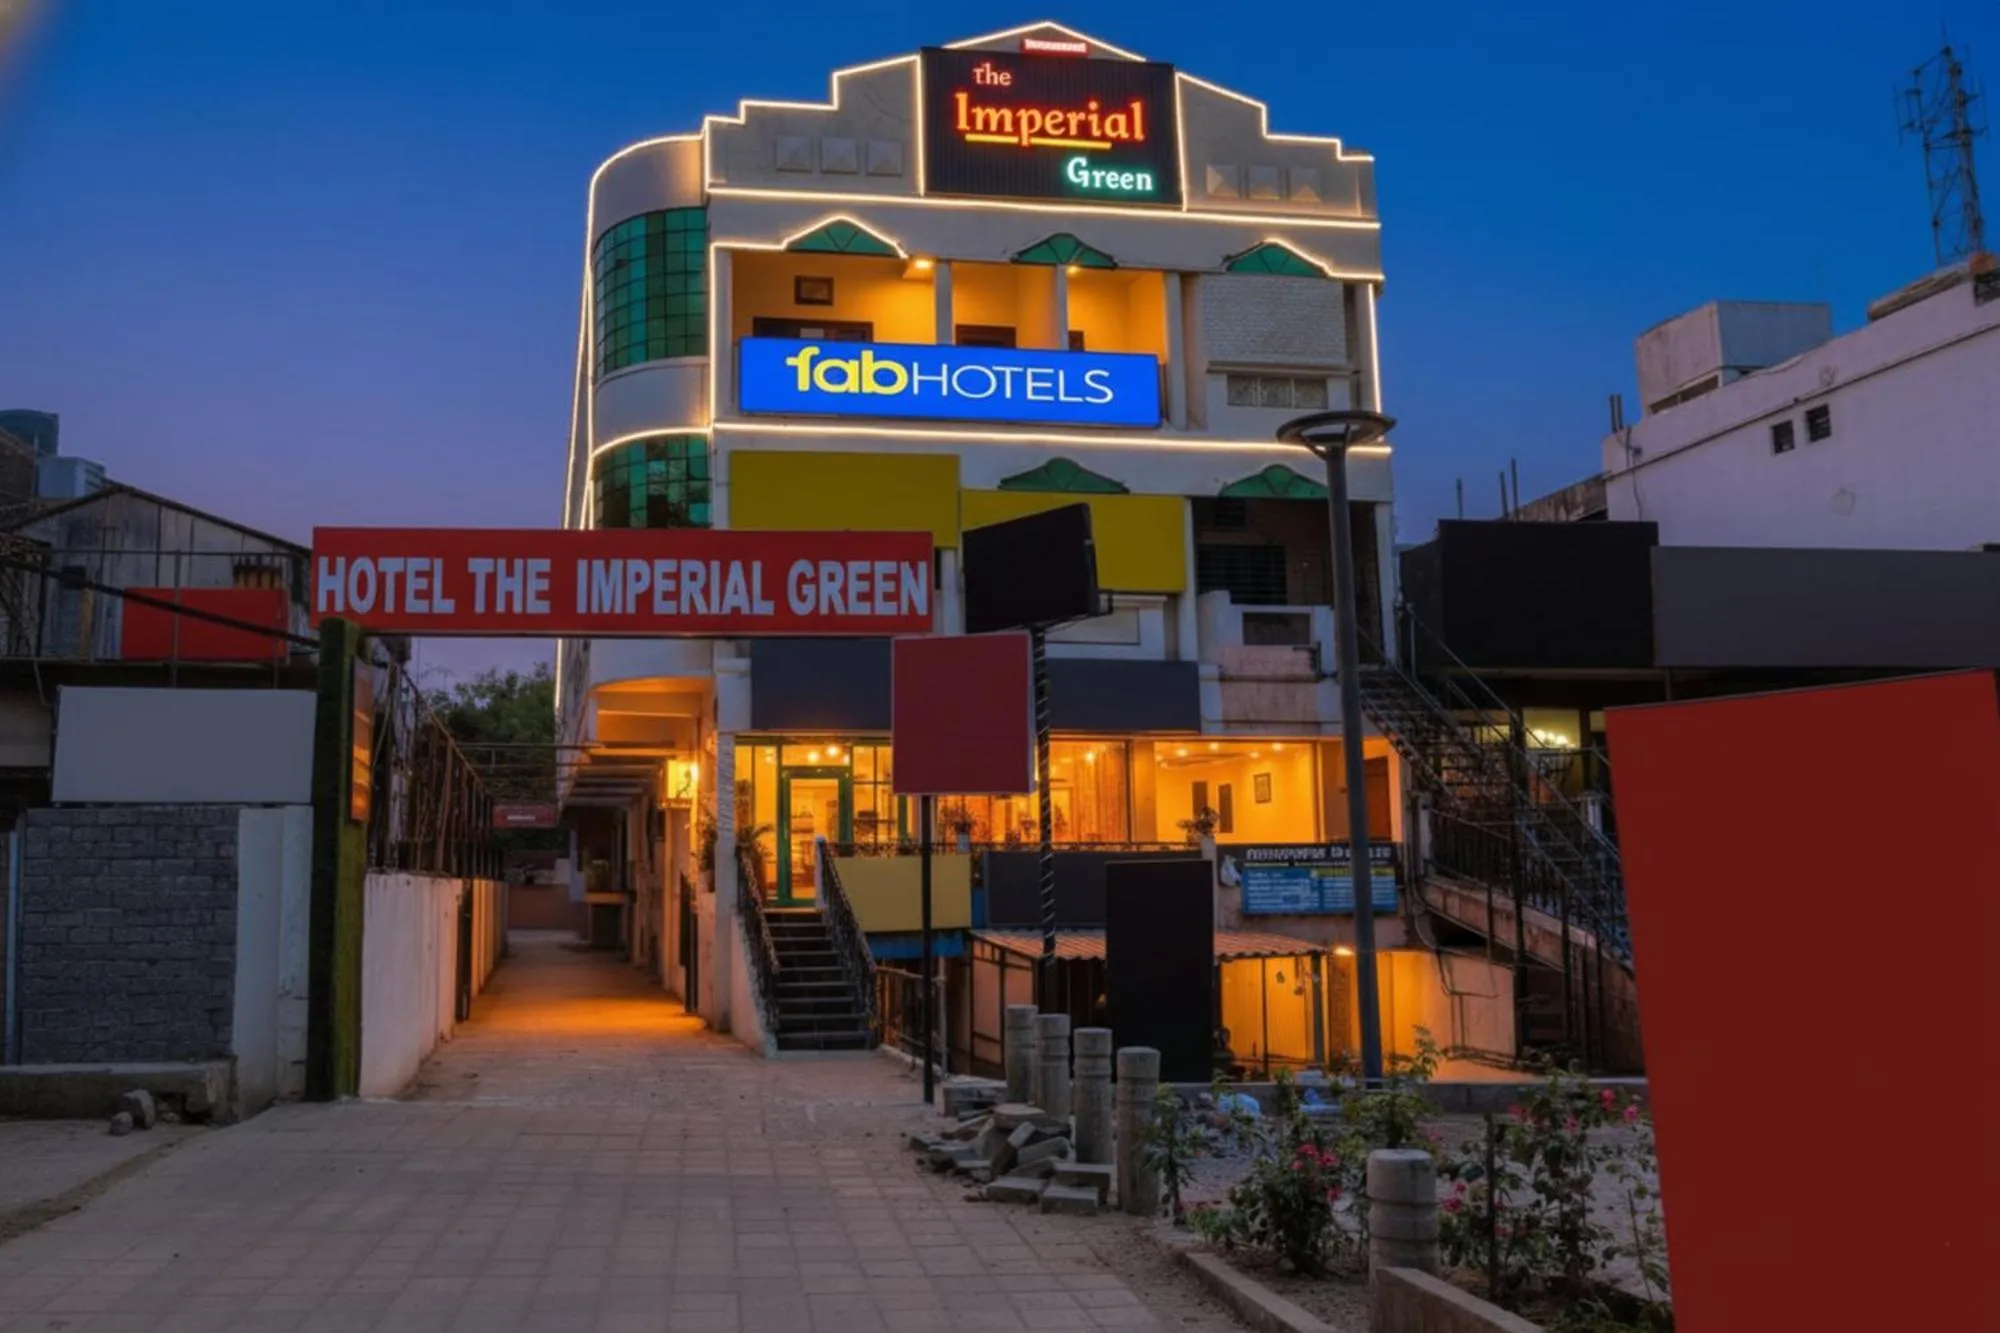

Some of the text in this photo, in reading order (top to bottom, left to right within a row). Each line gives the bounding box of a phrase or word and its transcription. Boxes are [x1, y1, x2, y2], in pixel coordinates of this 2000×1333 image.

[973, 62, 1012, 86] the
[954, 92, 1145, 147] Imperial
[1067, 157, 1153, 191] Green
[317, 556, 929, 617] HOTEL THE IMPERIAL GREEN
